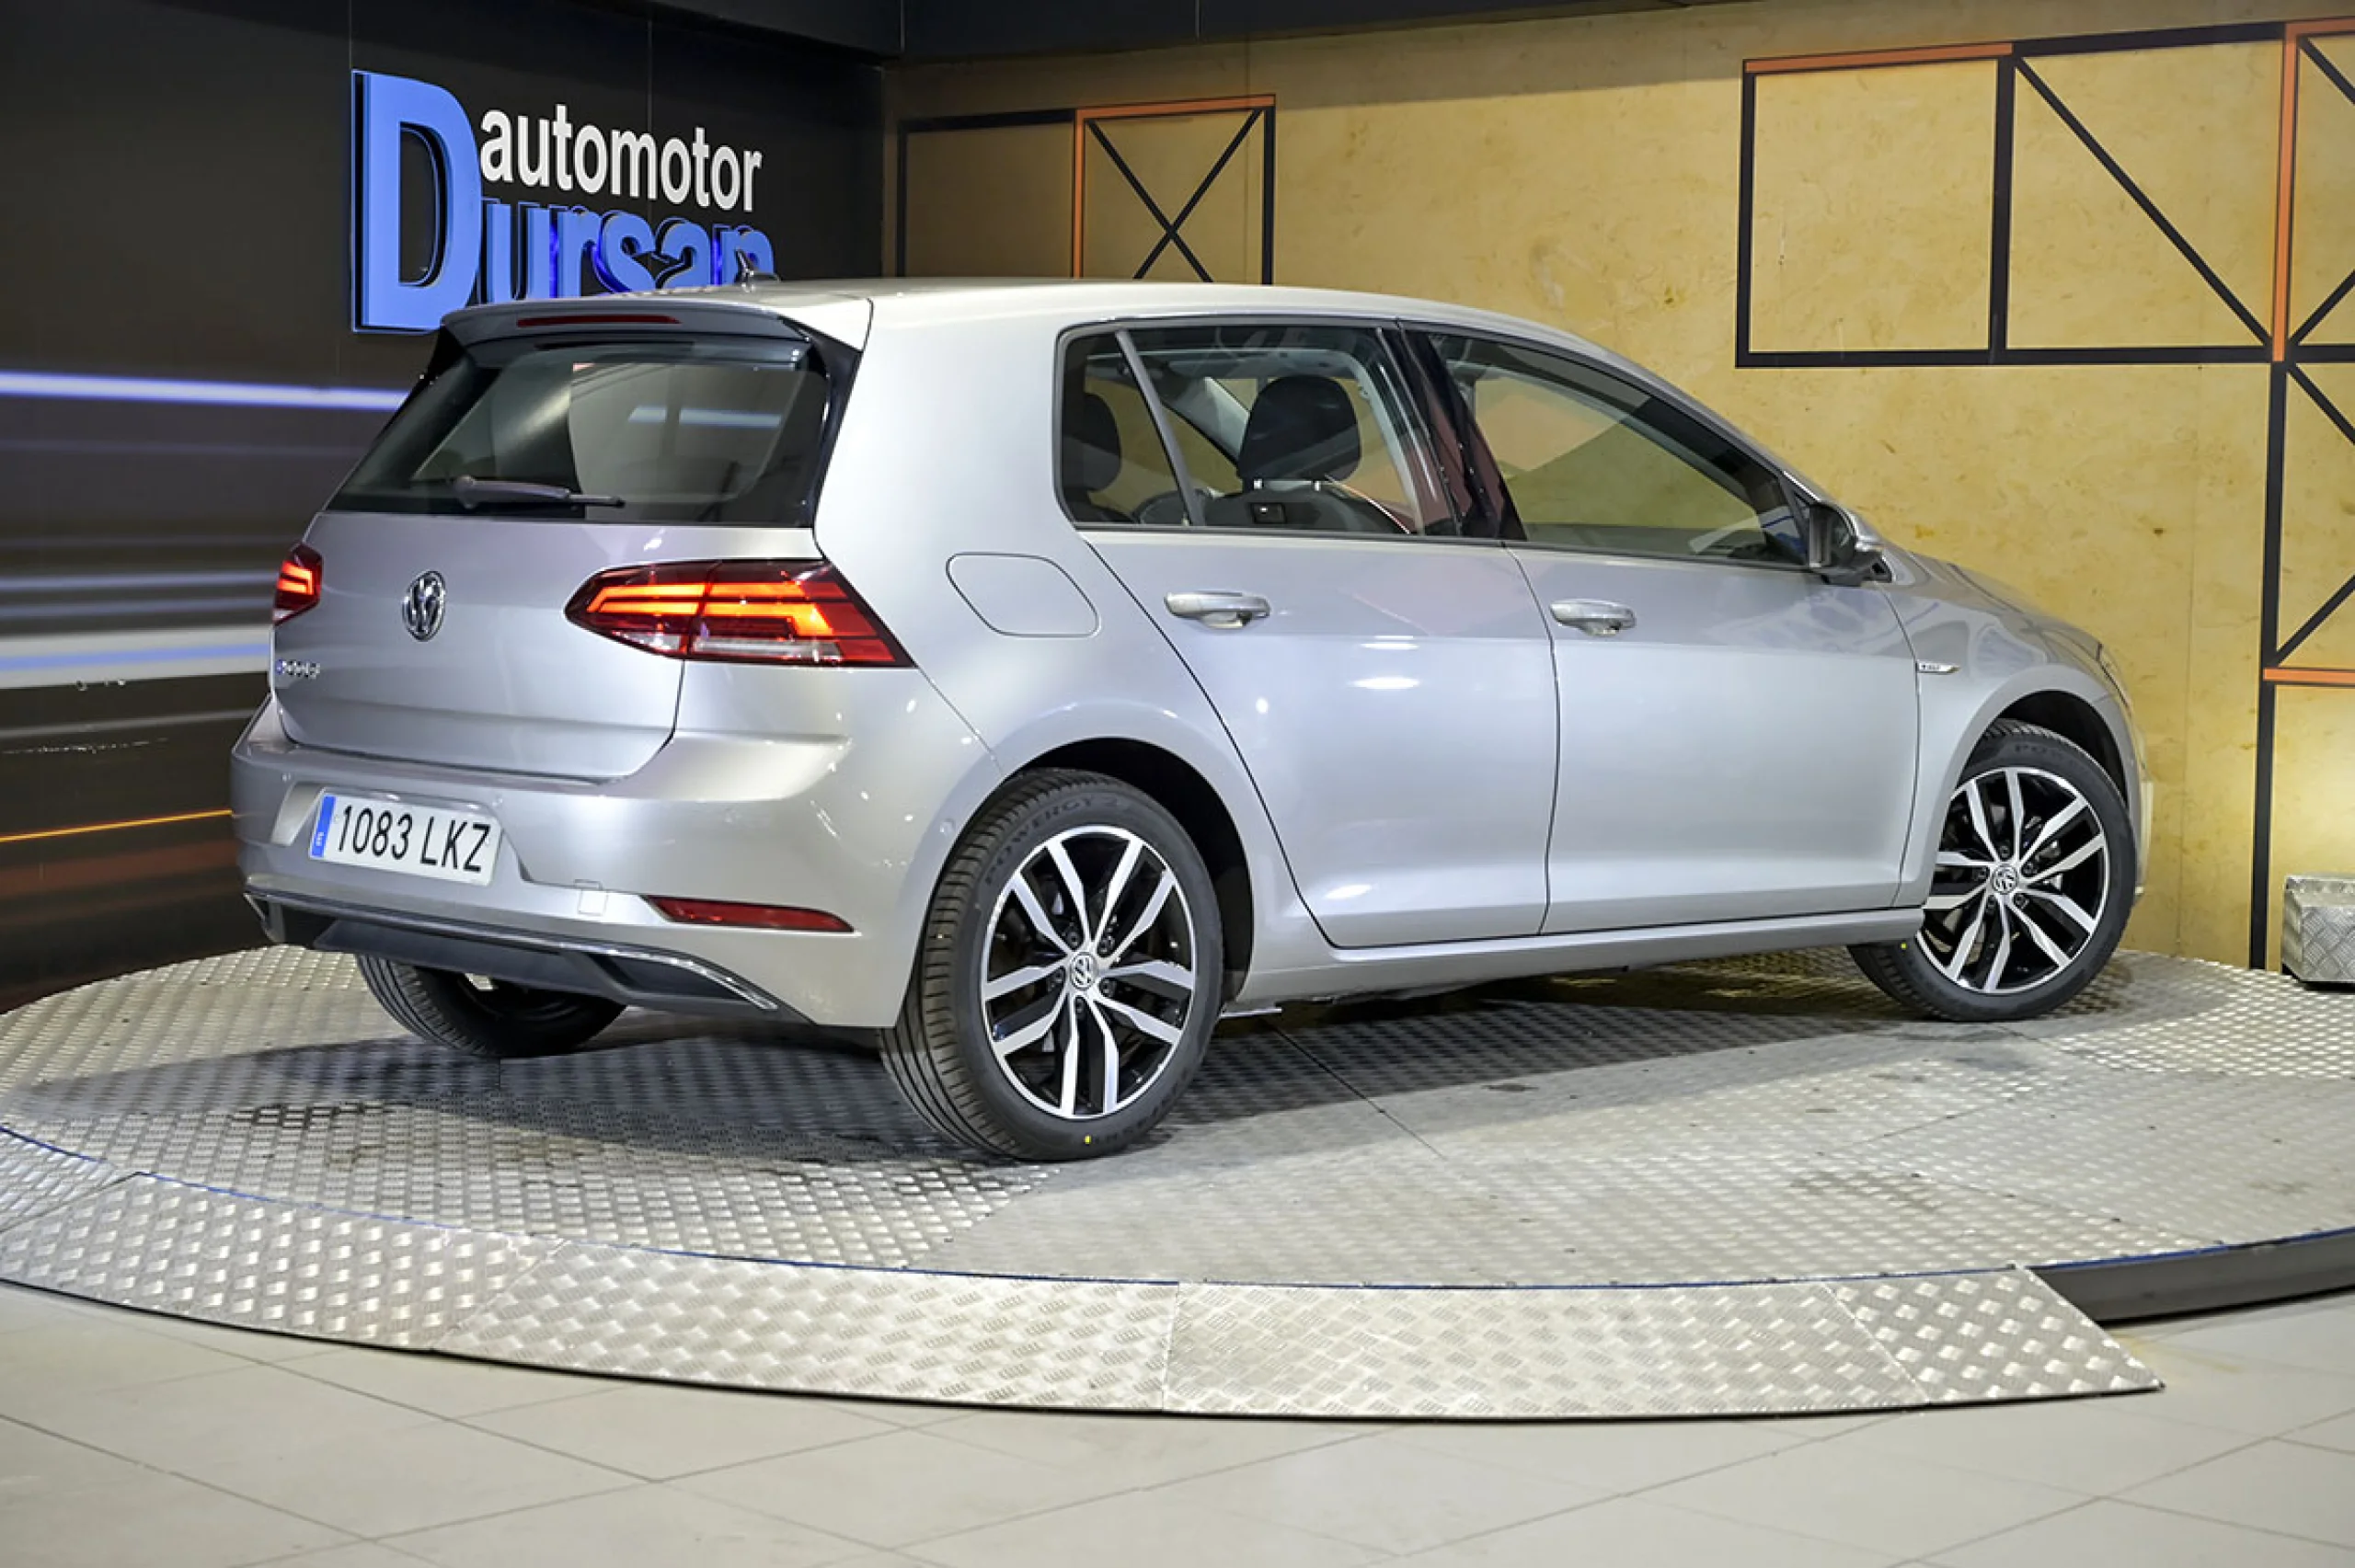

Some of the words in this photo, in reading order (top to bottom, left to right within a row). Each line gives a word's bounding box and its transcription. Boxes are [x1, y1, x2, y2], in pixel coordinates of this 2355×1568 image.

[480, 105, 762, 212] automotor
[338, 805, 413, 860] 1083
[419, 816, 491, 873] LKZ
